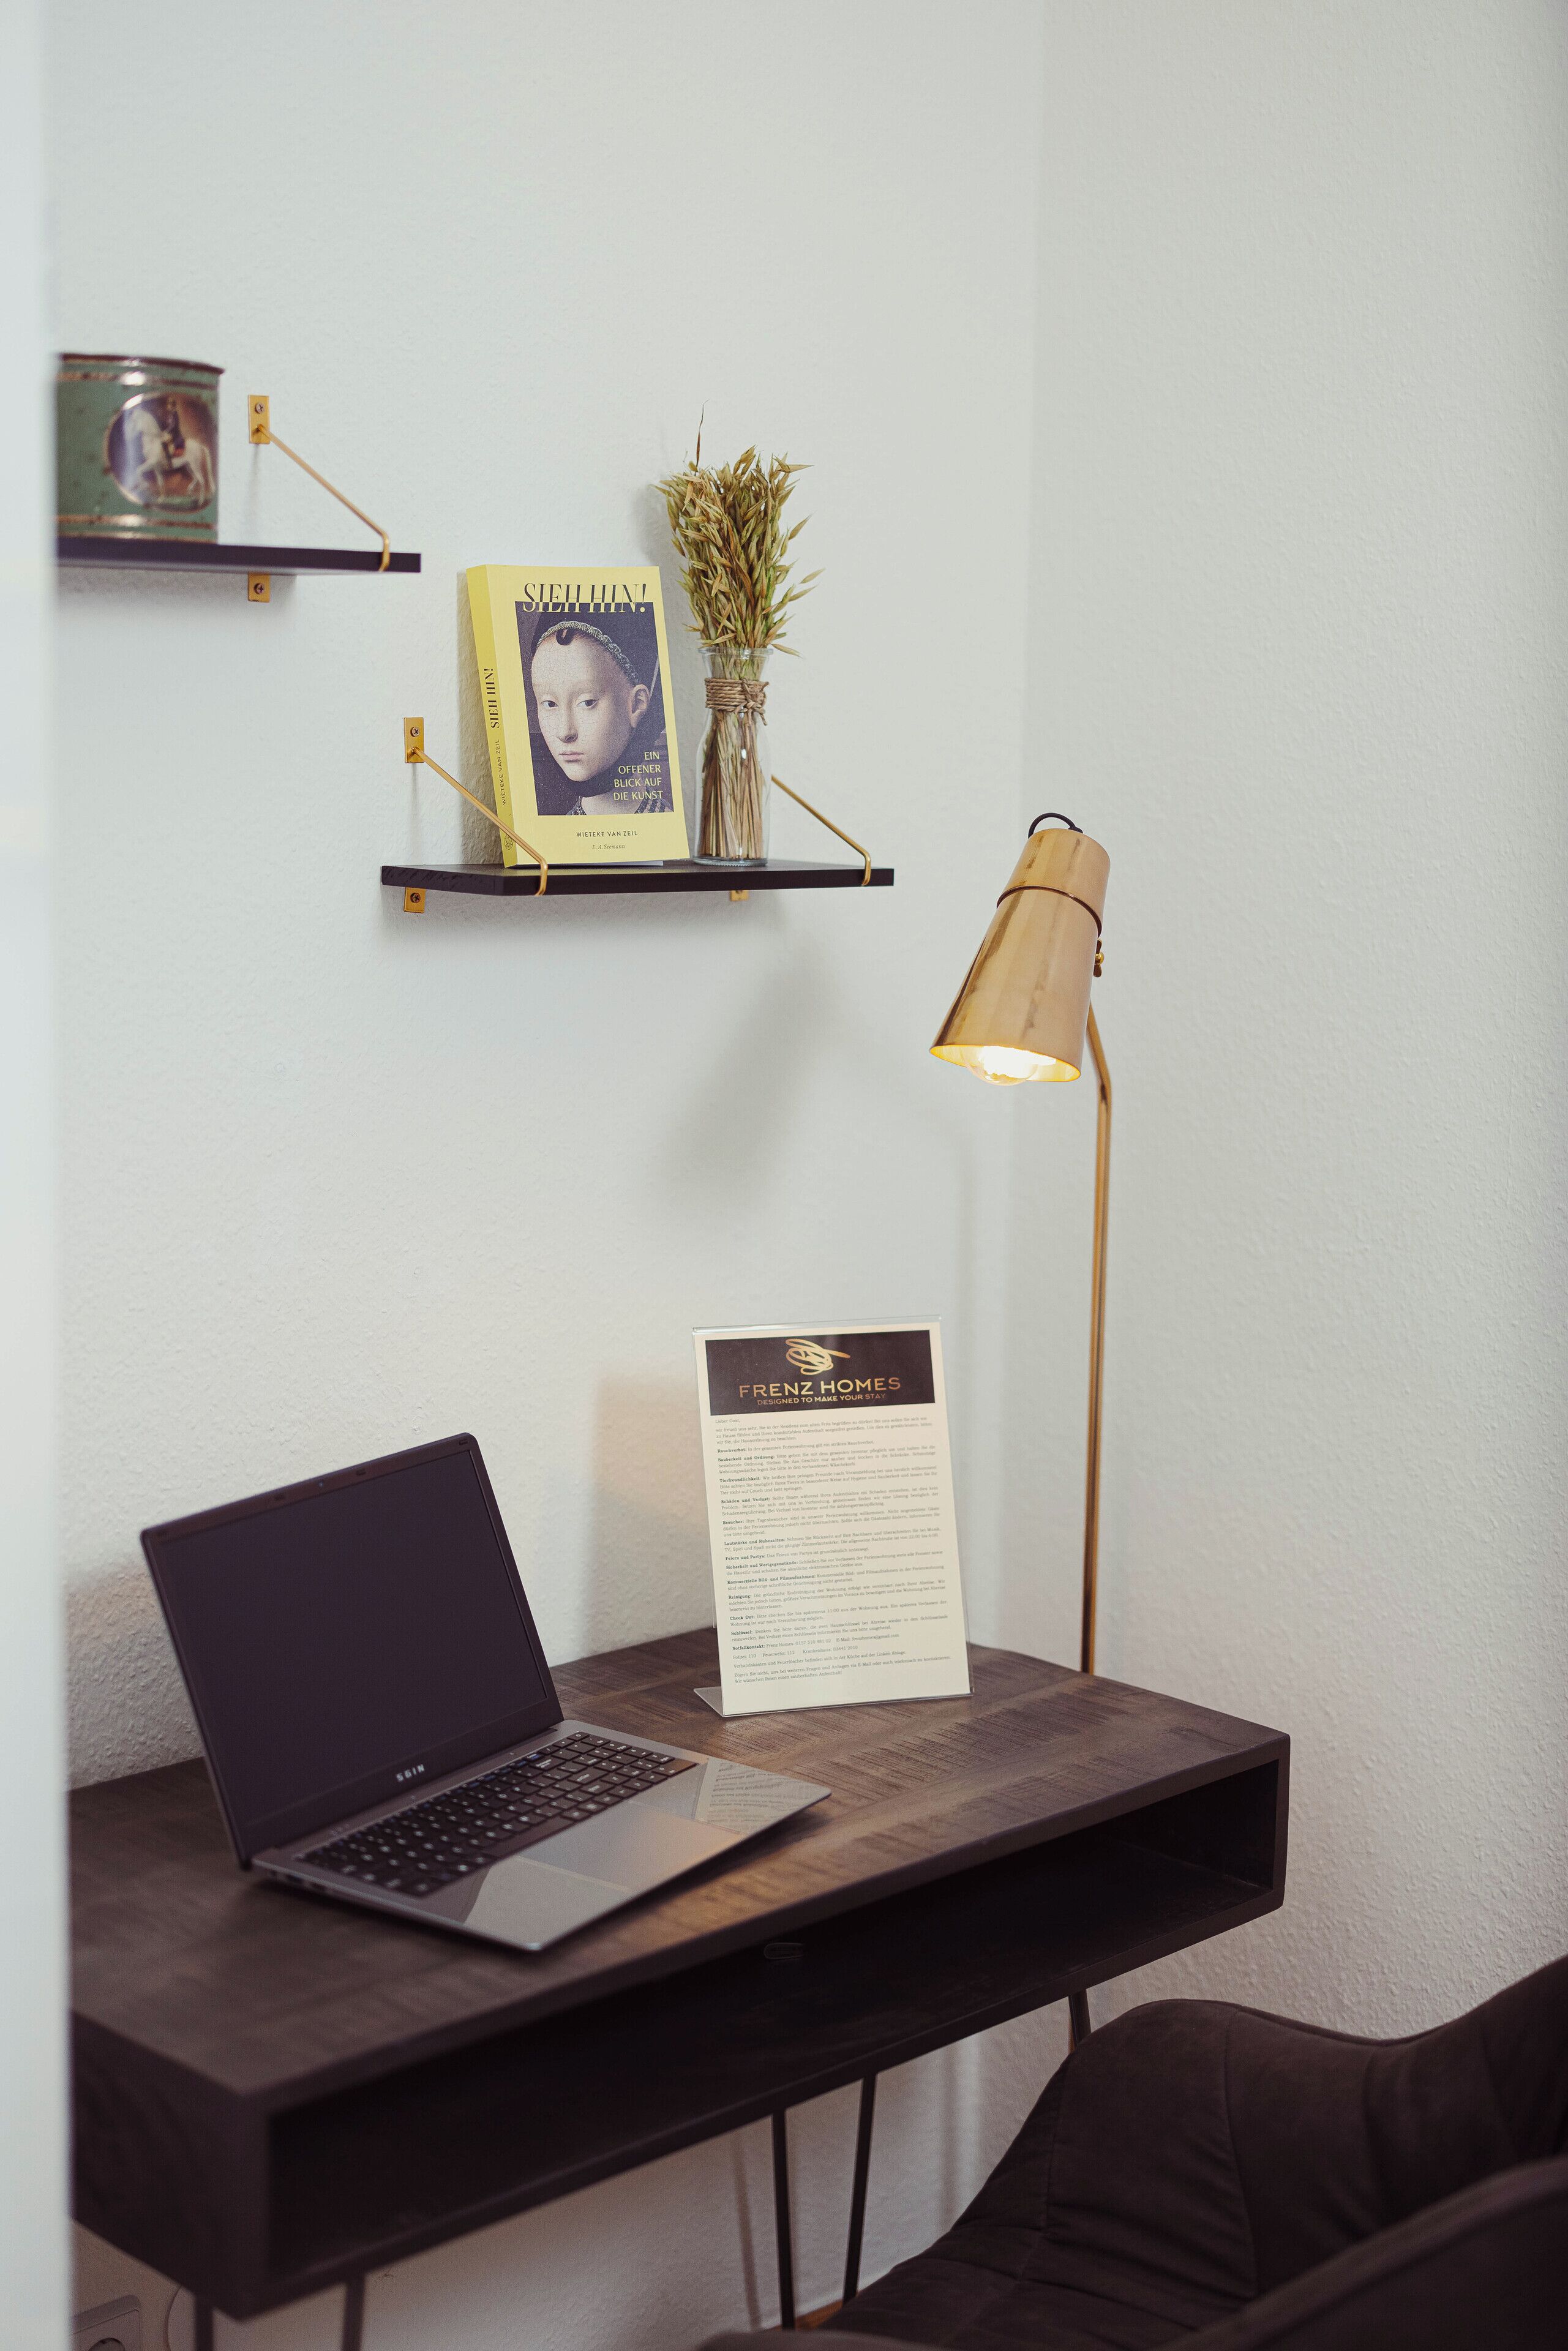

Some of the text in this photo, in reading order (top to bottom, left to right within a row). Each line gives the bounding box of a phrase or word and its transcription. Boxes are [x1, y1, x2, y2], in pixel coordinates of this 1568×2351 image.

[523, 583, 646, 613] SIEH HIN!
[484, 669, 500, 728] SIEH HIN!
[644, 751, 659, 760] EIN
[618, 765, 661, 774] OFFENER
[614, 778, 662, 787] BLICK AUF
[613, 790, 663, 801] DIE KUNST
[739, 1377, 901, 1398] FRENZ HOMES
